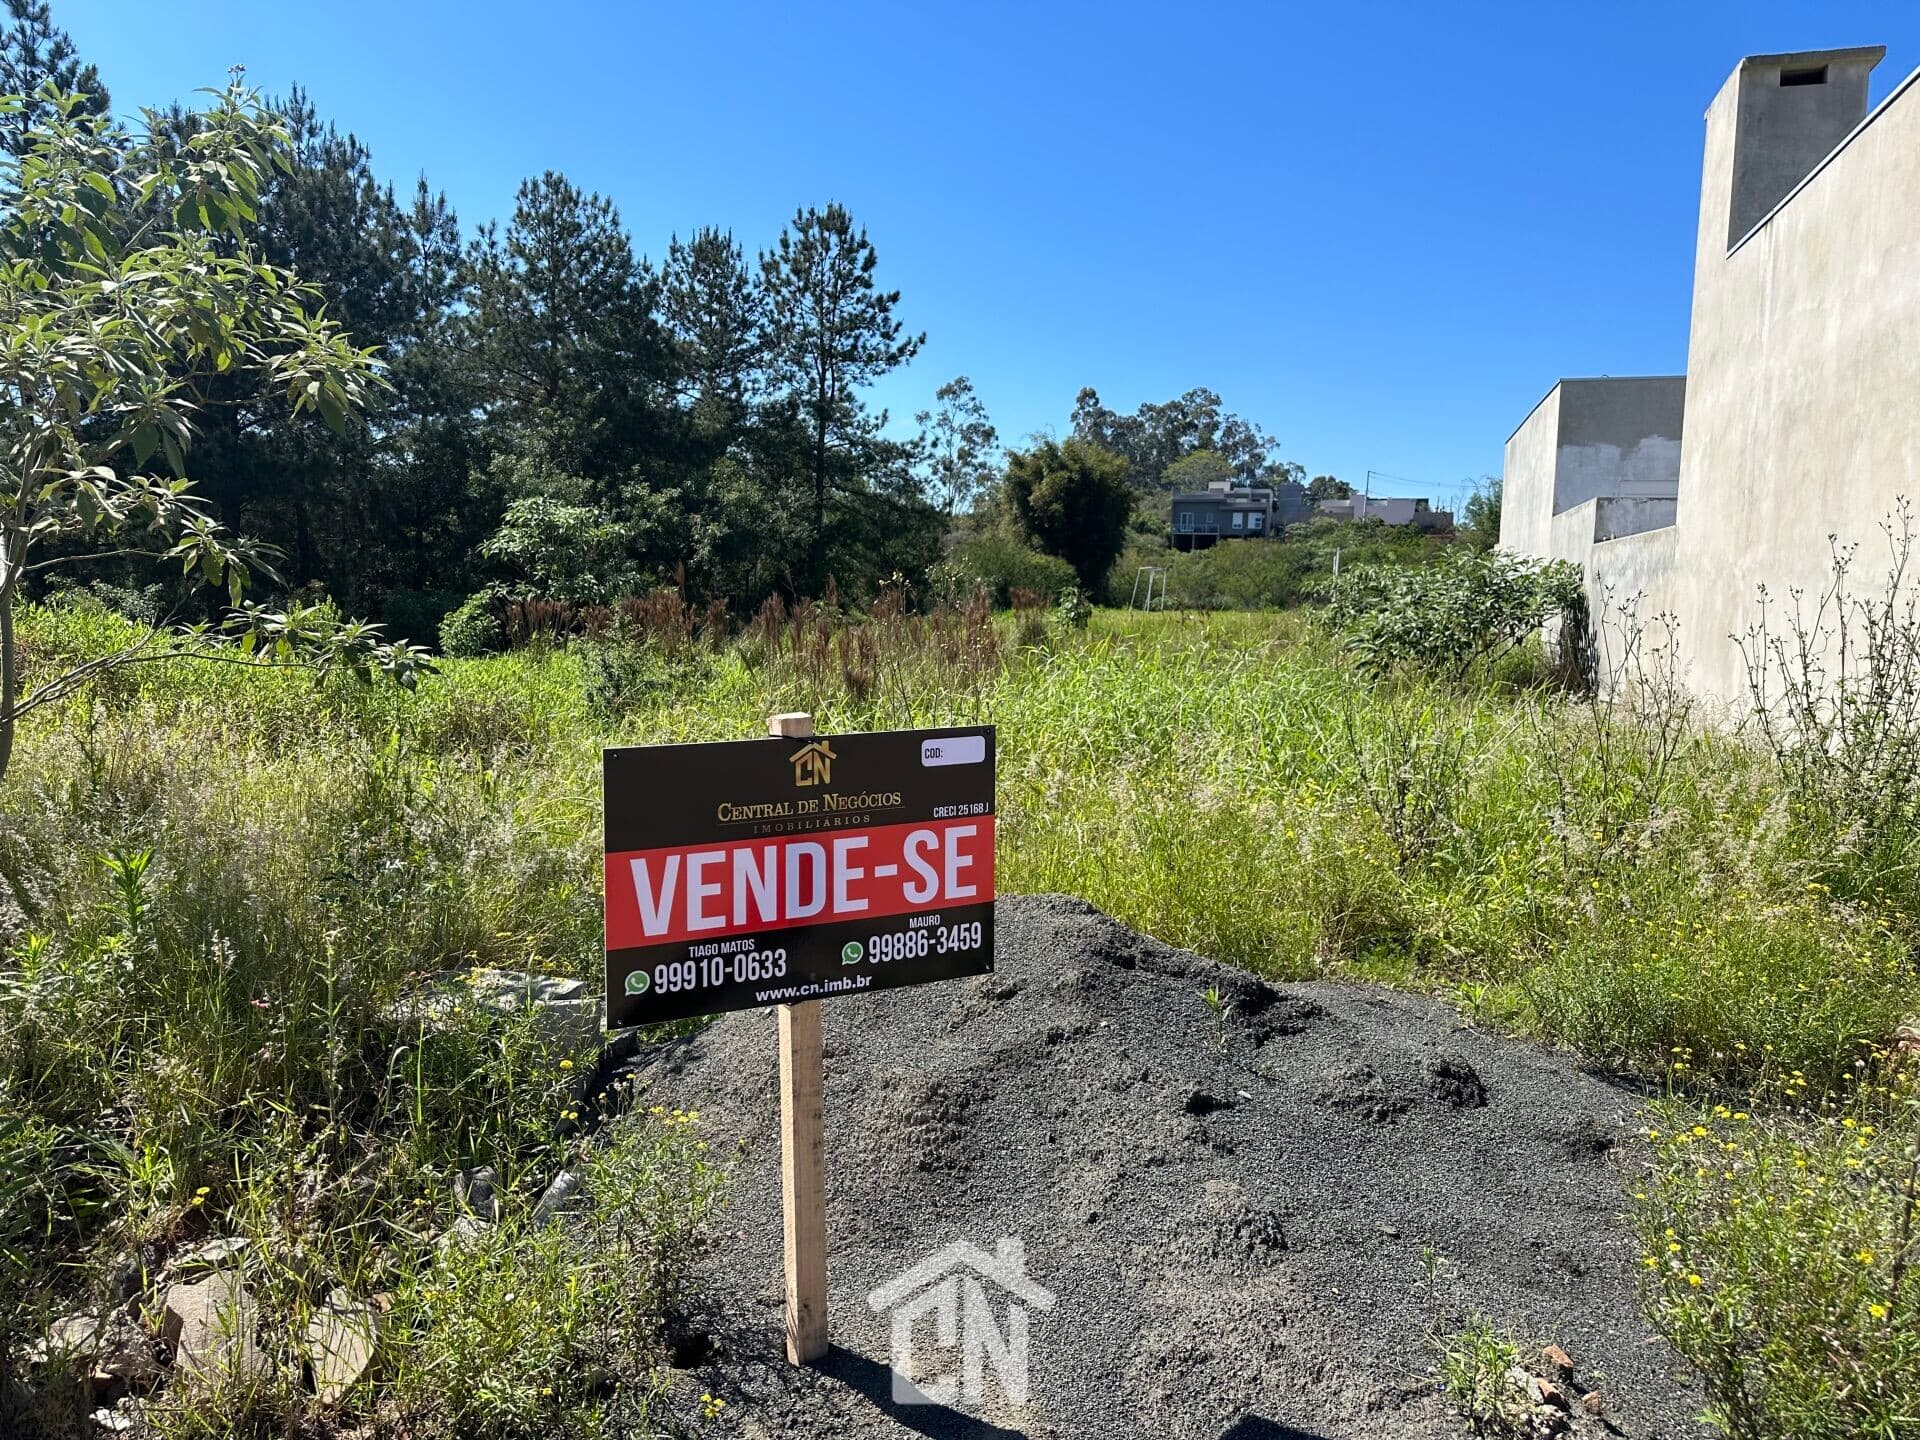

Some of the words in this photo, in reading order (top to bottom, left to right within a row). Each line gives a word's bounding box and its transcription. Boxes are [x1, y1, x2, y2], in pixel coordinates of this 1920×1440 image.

[924, 747, 944, 761] COD:
[716, 801, 794, 823] CENTRAL
[797, 799, 819, 814] DE
[822, 790, 902, 812] NEGÓCIOS
[933, 806, 957, 819] CRECI
[957, 803, 983, 817] 25168
[752, 814, 872, 834] IMOBILIÁRIOS
[629, 824, 978, 937] VENDE-SE
[909, 914, 941, 929] MAURO
[688, 943, 719, 958] TIAGO
[720, 938, 755, 955] MATOS
[867, 921, 983, 964] 99886-3459
[653, 948, 788, 994] 99910-0633
[754, 974, 873, 1002] www.cn.imb.br
